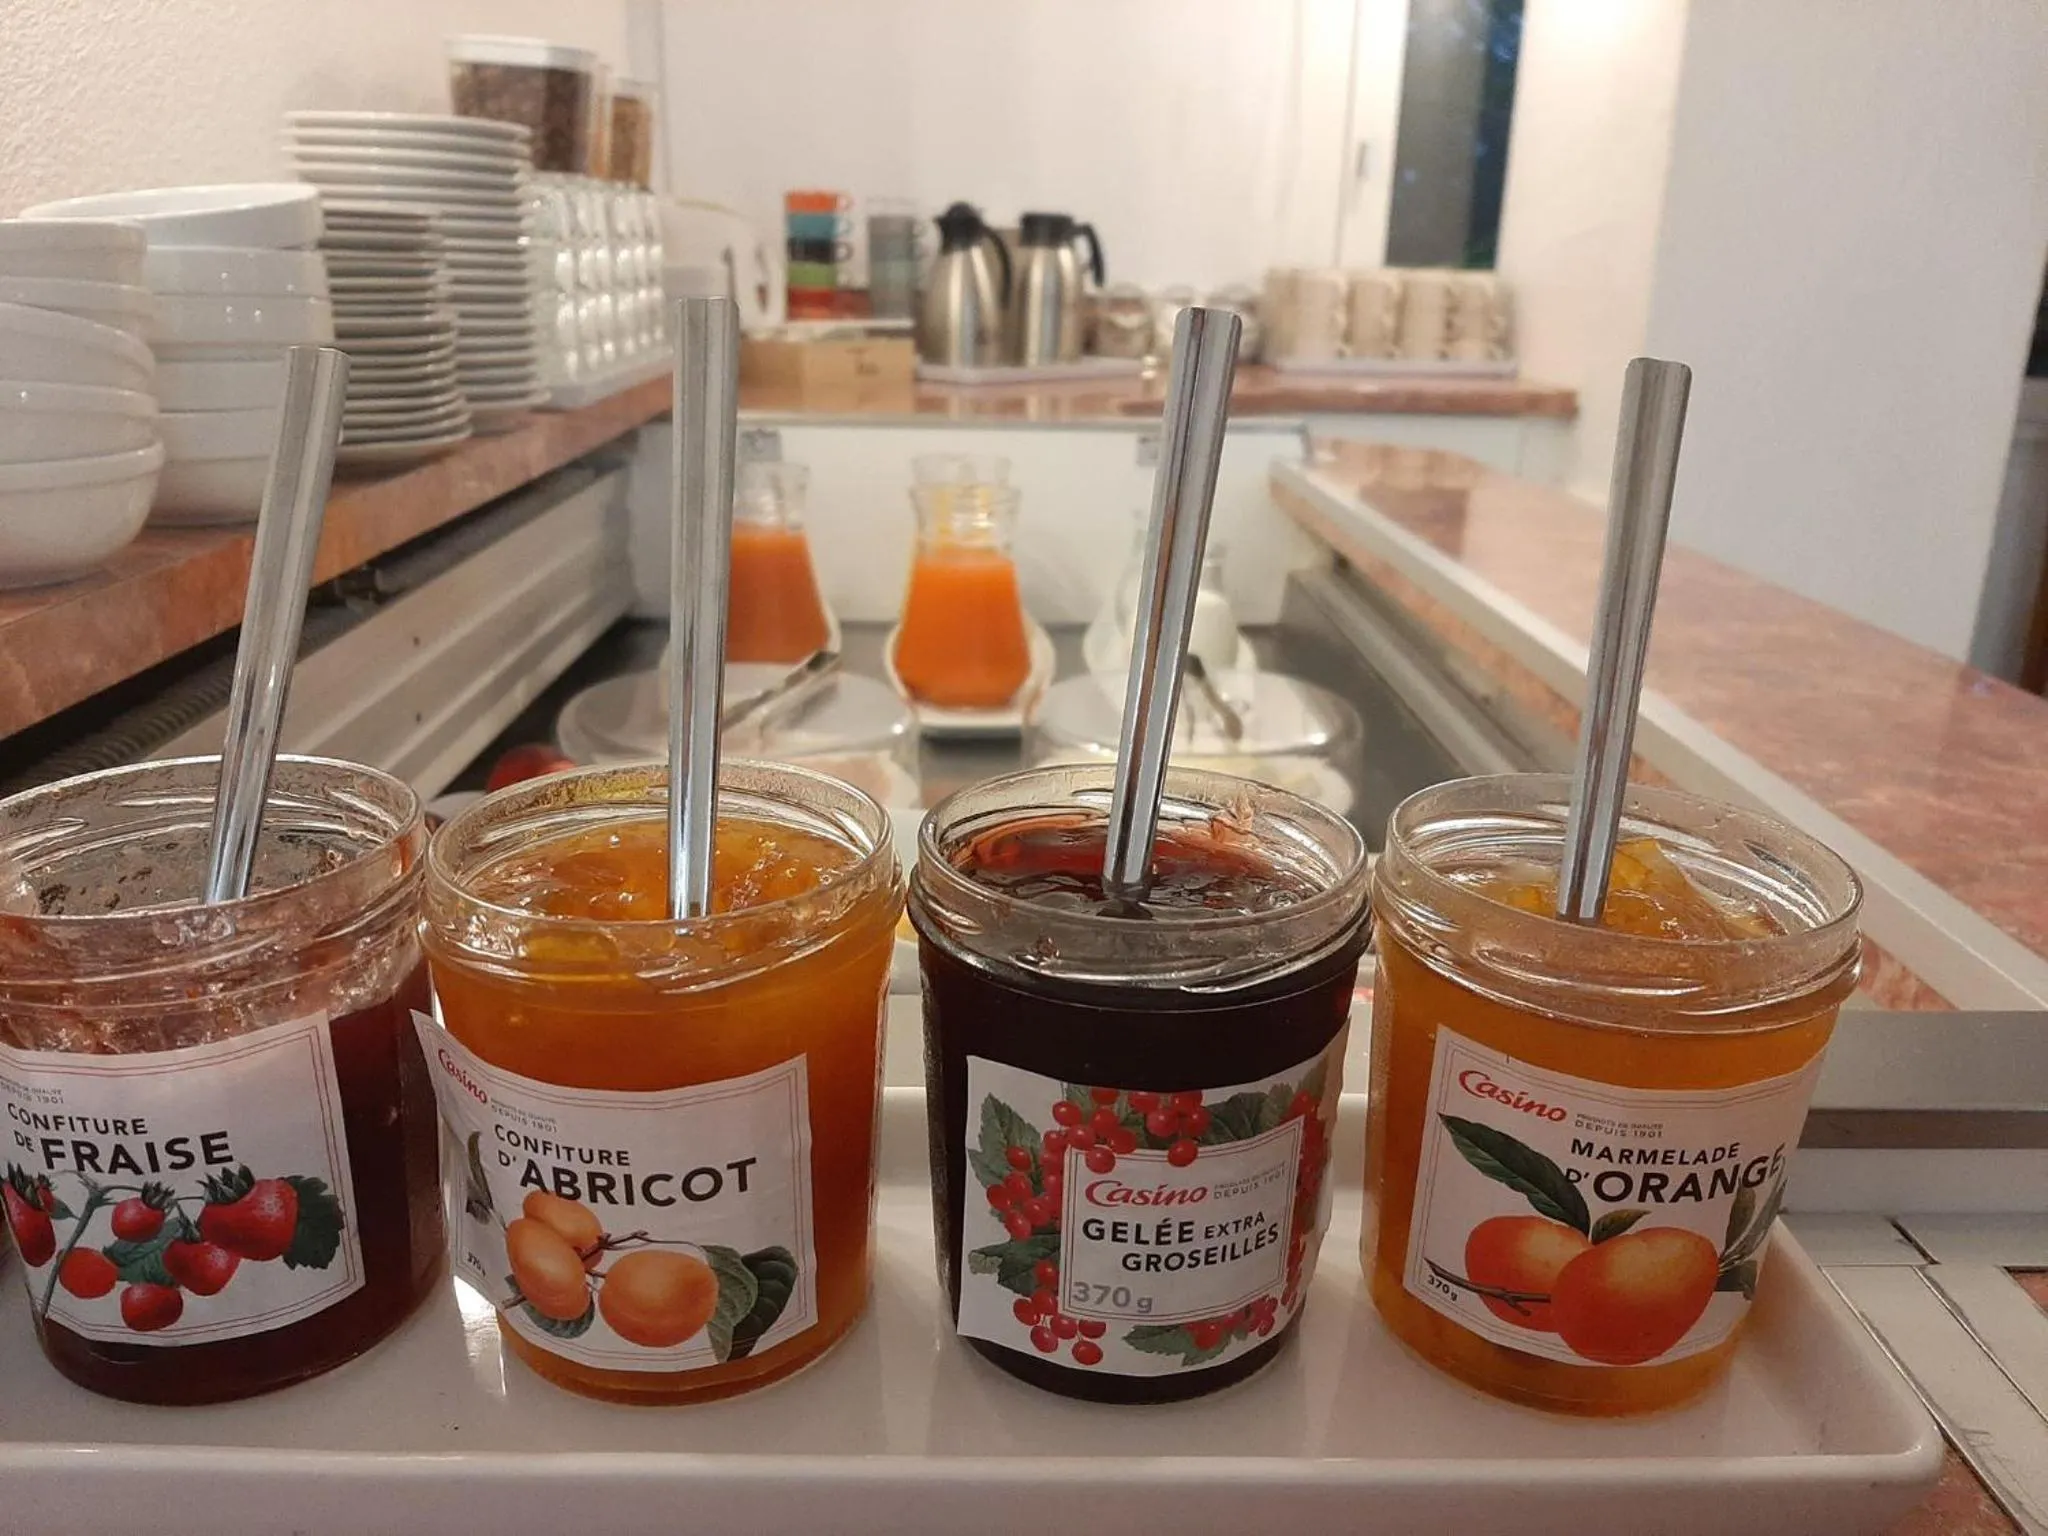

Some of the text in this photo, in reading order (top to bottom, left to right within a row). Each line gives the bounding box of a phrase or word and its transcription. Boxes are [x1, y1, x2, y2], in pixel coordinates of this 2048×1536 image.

[438, 1048, 488, 1105] Casino
[1458, 1068, 1568, 1123] Casino
[7, 1102, 148, 1136] CONFITURE
[1574, 1119, 1627, 1137] DEPUIS
[1633, 1130, 1663, 1138] 1901
[13, 1129, 234, 1176] DE FRAISE
[494, 1123, 631, 1167] CONFITURE
[1570, 1137, 1741, 1166] MARMELADE
[1085, 1179, 1209, 1208] Casino
[1213, 1182, 1260, 1200] DEPUIS
[1082, 1210, 1266, 1246] GELÉE EXTRA
[1121, 1222, 1279, 1273] GROSEILLES
